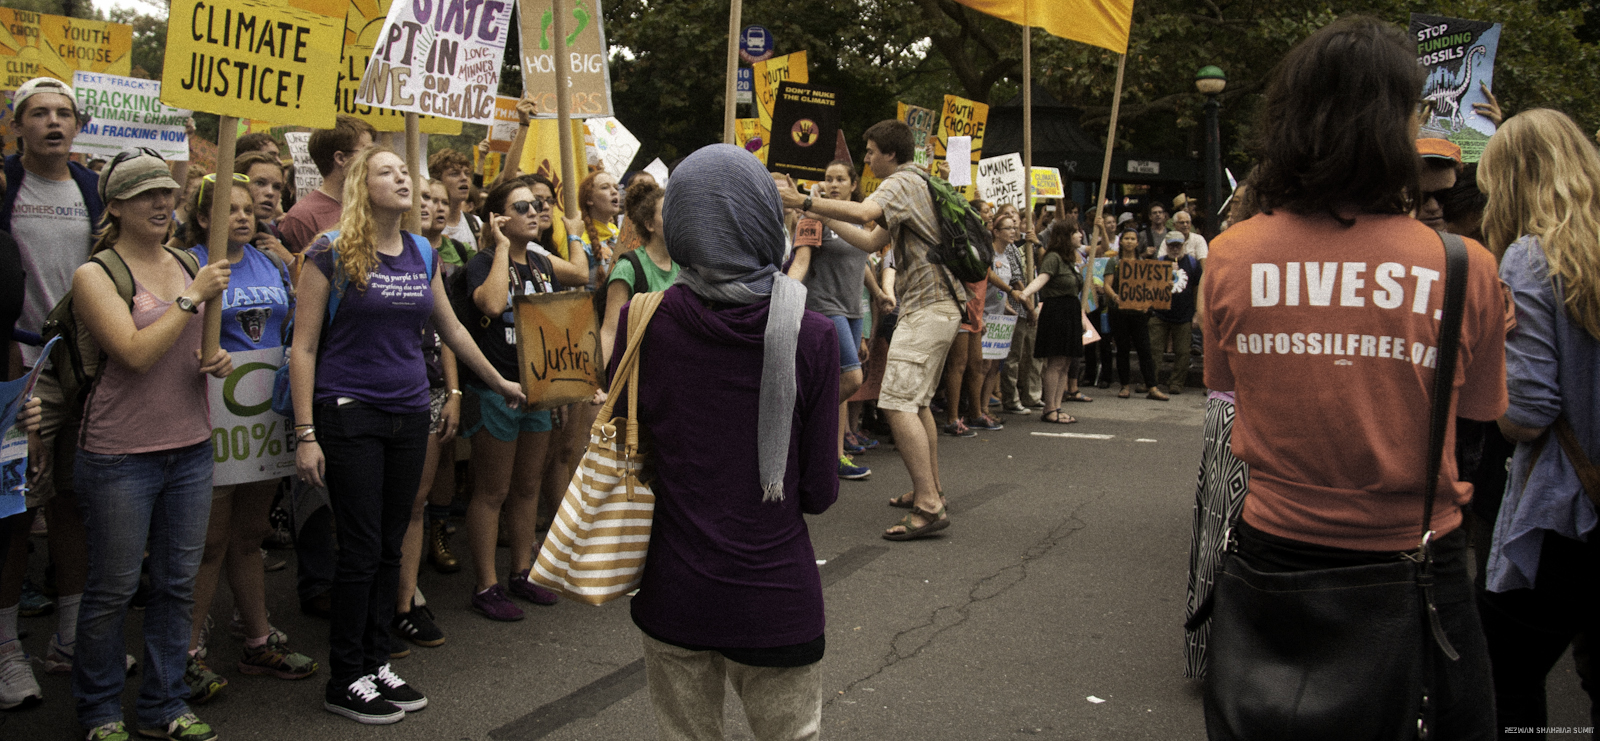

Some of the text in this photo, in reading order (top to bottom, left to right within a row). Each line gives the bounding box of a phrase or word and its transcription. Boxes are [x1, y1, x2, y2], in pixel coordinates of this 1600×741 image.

[13, 10, 40, 23] YOUT
[10, 24, 40, 37] CHOO
[62, 25, 111, 44] YOUTH
[191, 1, 311, 63] CLIMATE
[1417, 24, 1448, 41] STOP
[1417, 32, 1472, 54] FUNDING
[58, 44, 112, 63] CHOOSE
[425, 32, 459, 76] IN
[464, 47, 496, 61] LOVE,
[526, 52, 602, 74] HO BIG
[1416, 46, 1464, 66] FOSSILS
[6, 61, 40, 74] CLIMA
[762, 65, 790, 87] YOUTH
[76, 73, 103, 84] TEXT
[107, 77, 149, 90] "FRACK"
[181, 52, 305, 109] JUSTICE!
[424, 74, 451, 94] ON
[737, 80, 750, 90] 20
[75, 87, 161, 113] FRACKING
[420, 84, 495, 119] CLIMATE
[763, 88, 779, 105] CHO
[783, 93, 836, 106] THE CLIMATE
[785, 87, 835, 99] DON'T NUKE
[85, 105, 189, 127] CLIMATE CHANGE
[946, 98, 974, 121] YOUTH
[81, 123, 186, 142] AN FRACKING NOW
[944, 116, 984, 139] CHOOSE
[980, 158, 1015, 177] UMAINE
[1035, 174, 1057, 182] CLIMATE
[985, 180, 1018, 199] CLIMATE
[11, 204, 90, 217] MOTHERS OUT FRO
[390, 272, 412, 283] purple
[412, 272, 419, 280] is
[1122, 261, 1172, 282] DIVEST
[371, 282, 403, 292] Everything
[1120, 282, 1173, 302] Gustavus
[1251, 261, 1443, 320] DIVEST.
[221, 286, 289, 311] AIN
[986, 322, 1015, 333] FRACK
[1236, 332, 1439, 369] GOFOSSILFREE.OR
